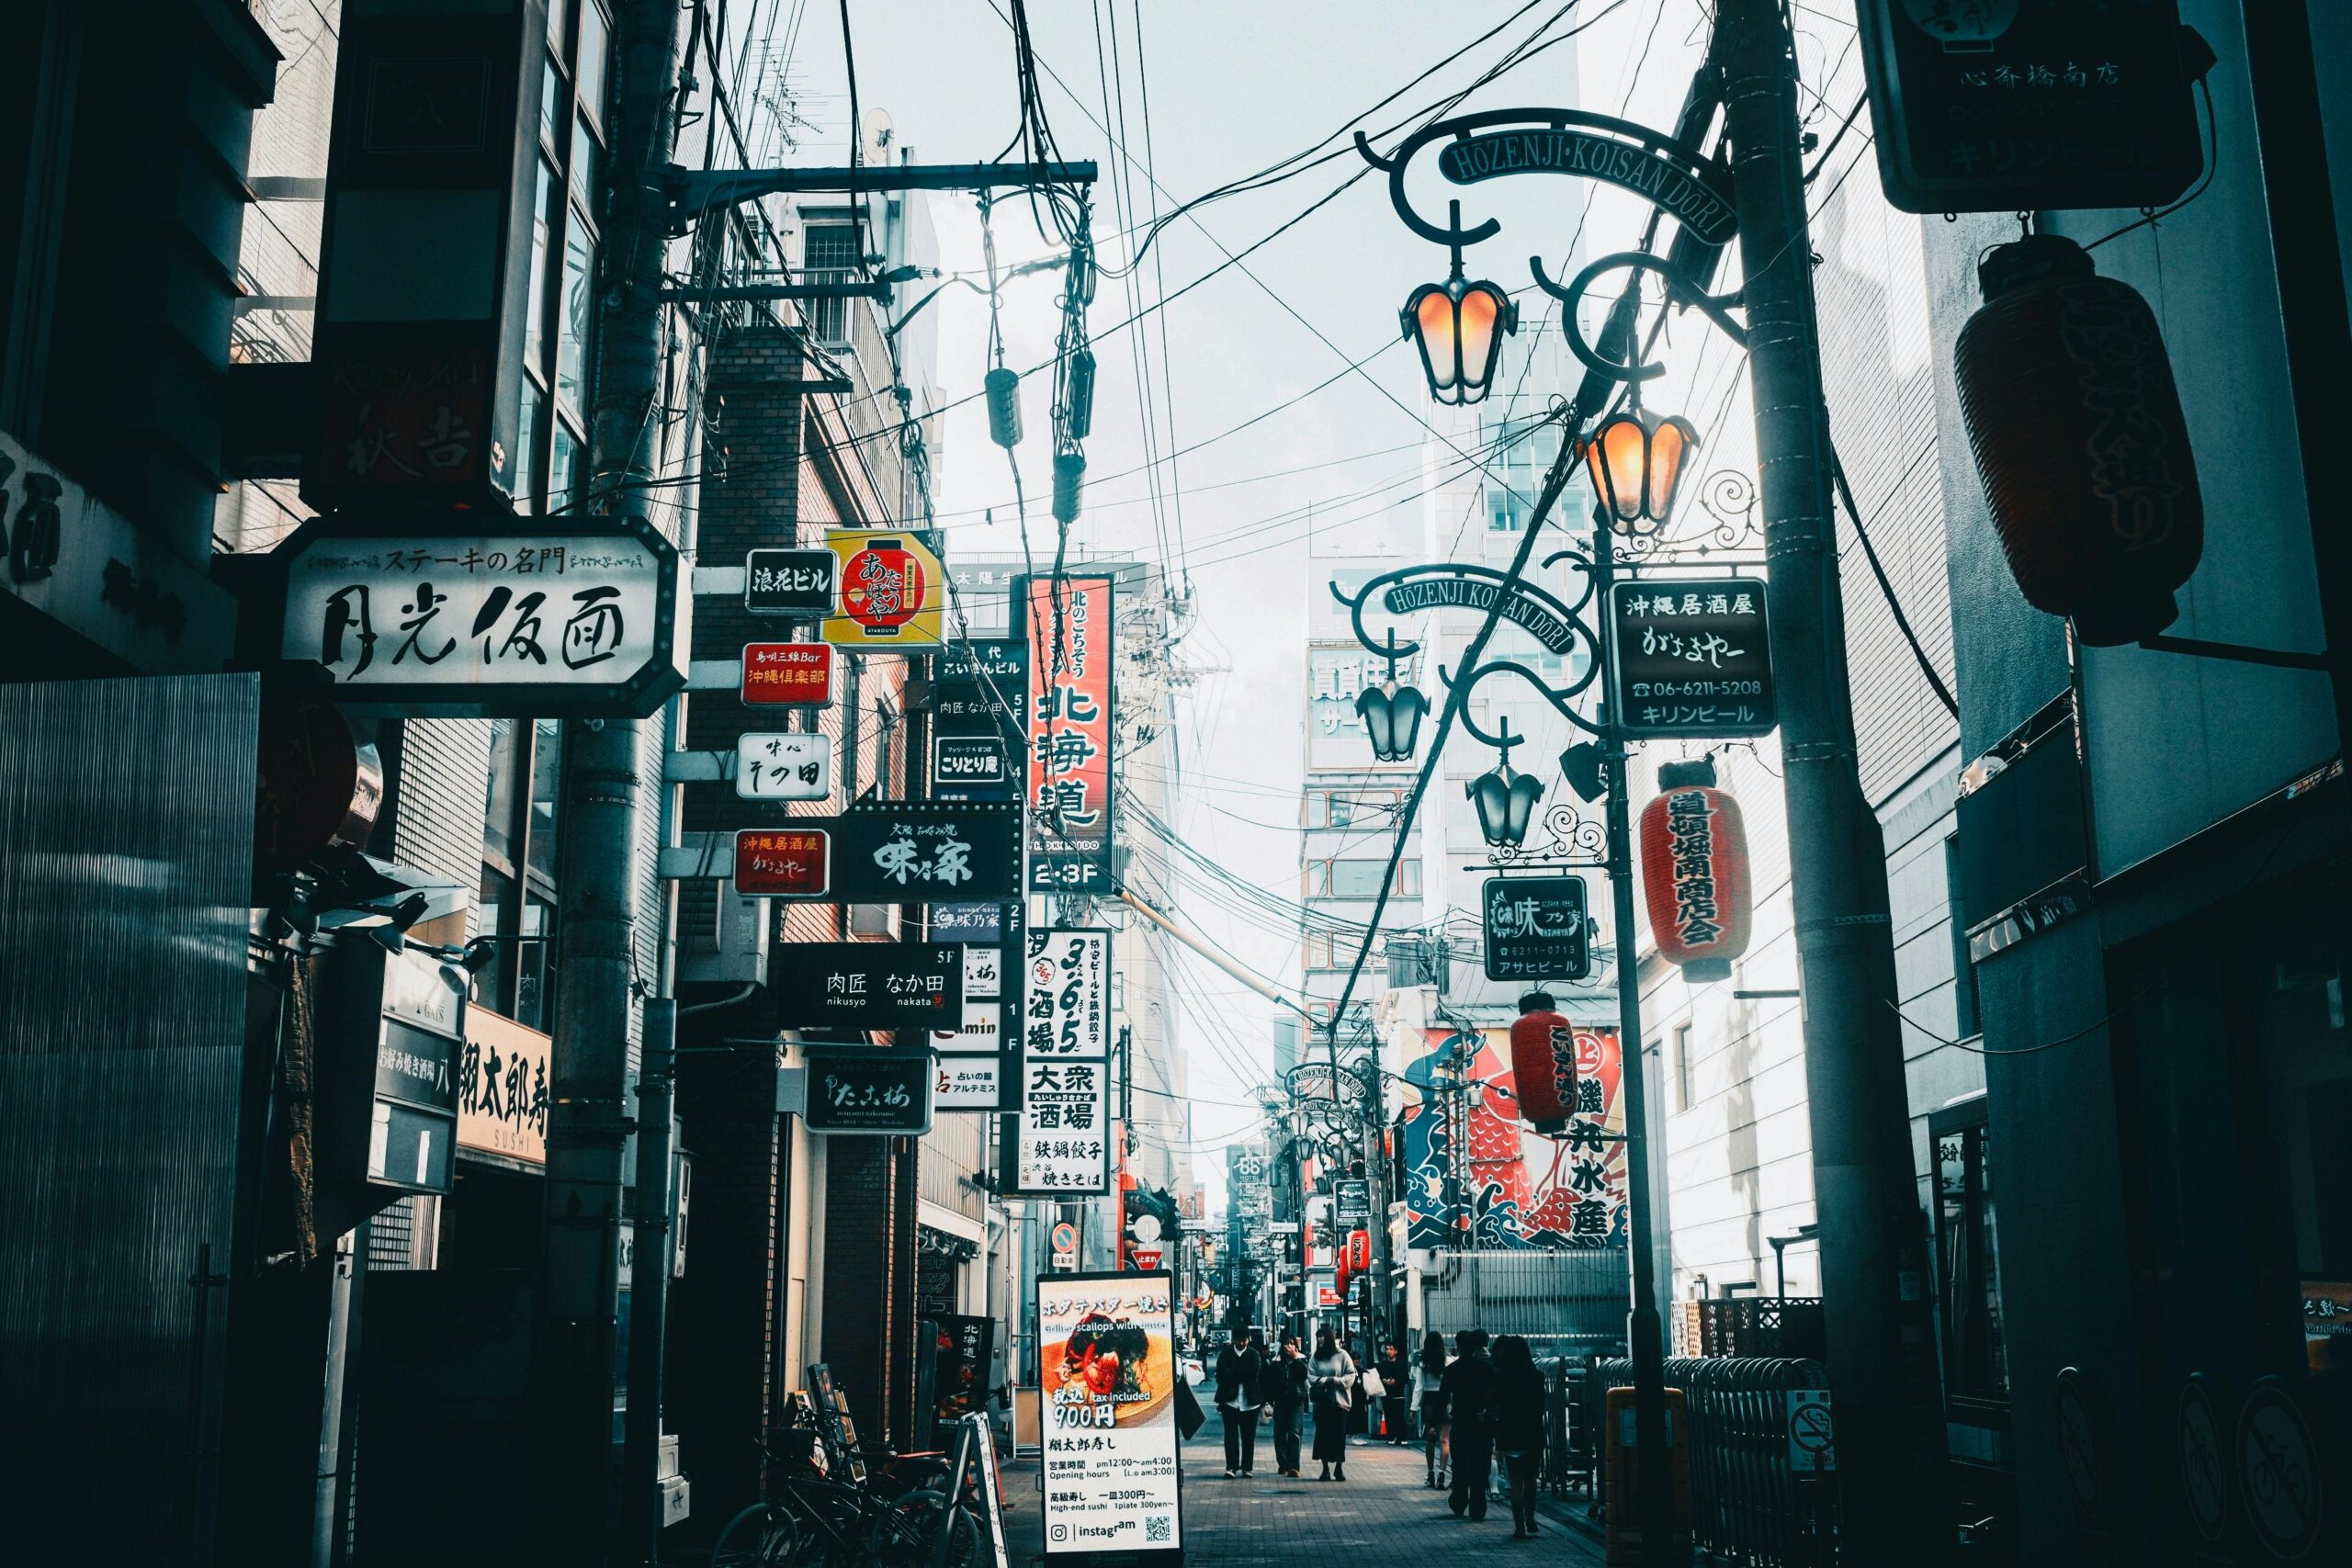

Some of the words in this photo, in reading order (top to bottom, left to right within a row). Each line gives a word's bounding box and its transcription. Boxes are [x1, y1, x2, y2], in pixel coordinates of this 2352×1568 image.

[1961, 62, 2120, 89] 心斎橋南店
[345, 397, 471, 477] 秋吉
[386, 547, 566, 575] ステーキの名門
[752, 568, 830, 592] 浪花ビル
[1626, 593, 1756, 618] 沖縄居酒屋
[322, 582, 624, 682] 月光仮面
[1071, 592, 1088, 678] 北のごちそう
[1654, 682, 1762, 696] 06-6211-5208
[940, 702, 964, 714] 肉匠
[967, 702, 1002, 714] なか田
[1642, 705, 1754, 724] キリンビール
[1036, 685, 1098, 826] 北海道
[743, 837, 819, 851] 沖縄居酒屋
[872, 836, 974, 886] 味乃家
[1668, 791, 1721, 946] 道頓堀南商店会
[957, 913, 1001, 928] 味乃家
[1011, 904, 1020, 931] 2F
[936, 951, 956, 964] 5F
[1035, 963, 1052, 983] 365
[1498, 961, 1578, 974] アサヒビール
[827, 972, 867, 994] 肉匠
[886, 973, 944, 994] なか田
[827, 997, 866, 1008] nikusyo
[897, 997, 932, 1006] nakata
[1027, 988, 1055, 1054] 酒場
[957, 1072, 992, 1080] 占いの館
[1031, 1065, 1095, 1091] 大衆
[952, 1084, 997, 1094] アルテミス
[1030, 1103, 1094, 1130] 酒場
[492, 1127, 530, 1153] SUSHI
[1035, 1140, 1102, 1160] 鉄鍋餃子
[1032, 1163, 1052, 1172] 渋谷
[1043, 1172, 1102, 1187] 焼きそば
[1054, 1256, 1074, 1264] 自動車
[1043, 1295, 1169, 1316] ホタテバター焼き
[1076, 1322, 1115, 1335] scallops
[1115, 1321, 1137, 1330] with
[963, 1324, 978, 1359] 北海道
[1052, 1388, 1085, 1405] 税込
[1093, 1393, 1108, 1403] tax
[1109, 1390, 1151, 1402] included
[1054, 1403, 1115, 1429] 900円
[1048, 1437, 1117, 1452] 翔太郎寿し
[1049, 1460, 1086, 1471] 営業時間
[1049, 1472, 1084, 1480] Opening
[1049, 1492, 1088, 1503] 高級寿し
[1050, 1504, 1086, 1513] High-end
[1079, 1519, 1136, 1538] instagram
